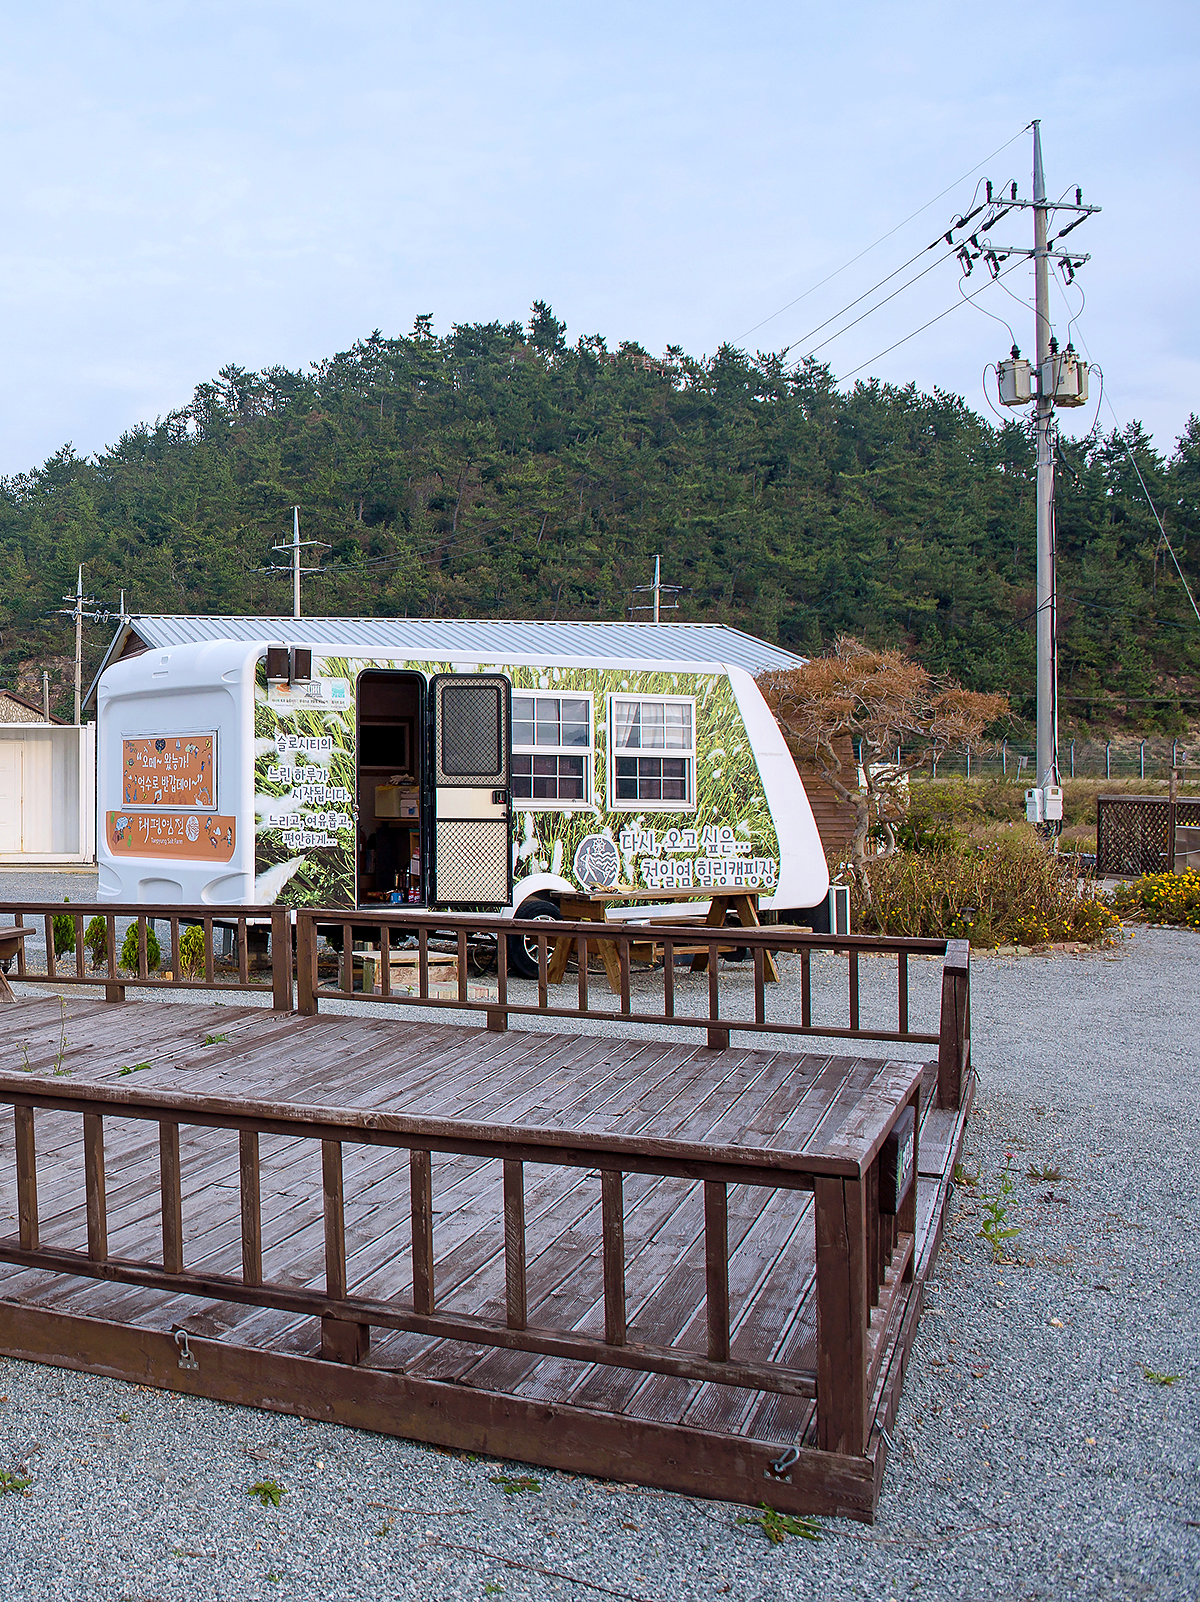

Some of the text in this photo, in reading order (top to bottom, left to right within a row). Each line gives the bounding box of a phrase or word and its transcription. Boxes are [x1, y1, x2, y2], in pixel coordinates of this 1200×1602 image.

[277, 735, 331, 752] 슬로시티의
[269, 767, 328, 783] 느린 하루가
[137, 775, 159, 792] 억수로
[292, 786, 350, 802] 시작됩니다.
[269, 812, 352, 828] 느리고, 여유롭고,
[284, 832, 336, 847] 편안하게...
[622, 828, 749, 854] 다시, 오고 싶은...
[642, 860, 775, 887] 천일염 힐링캠핑장
